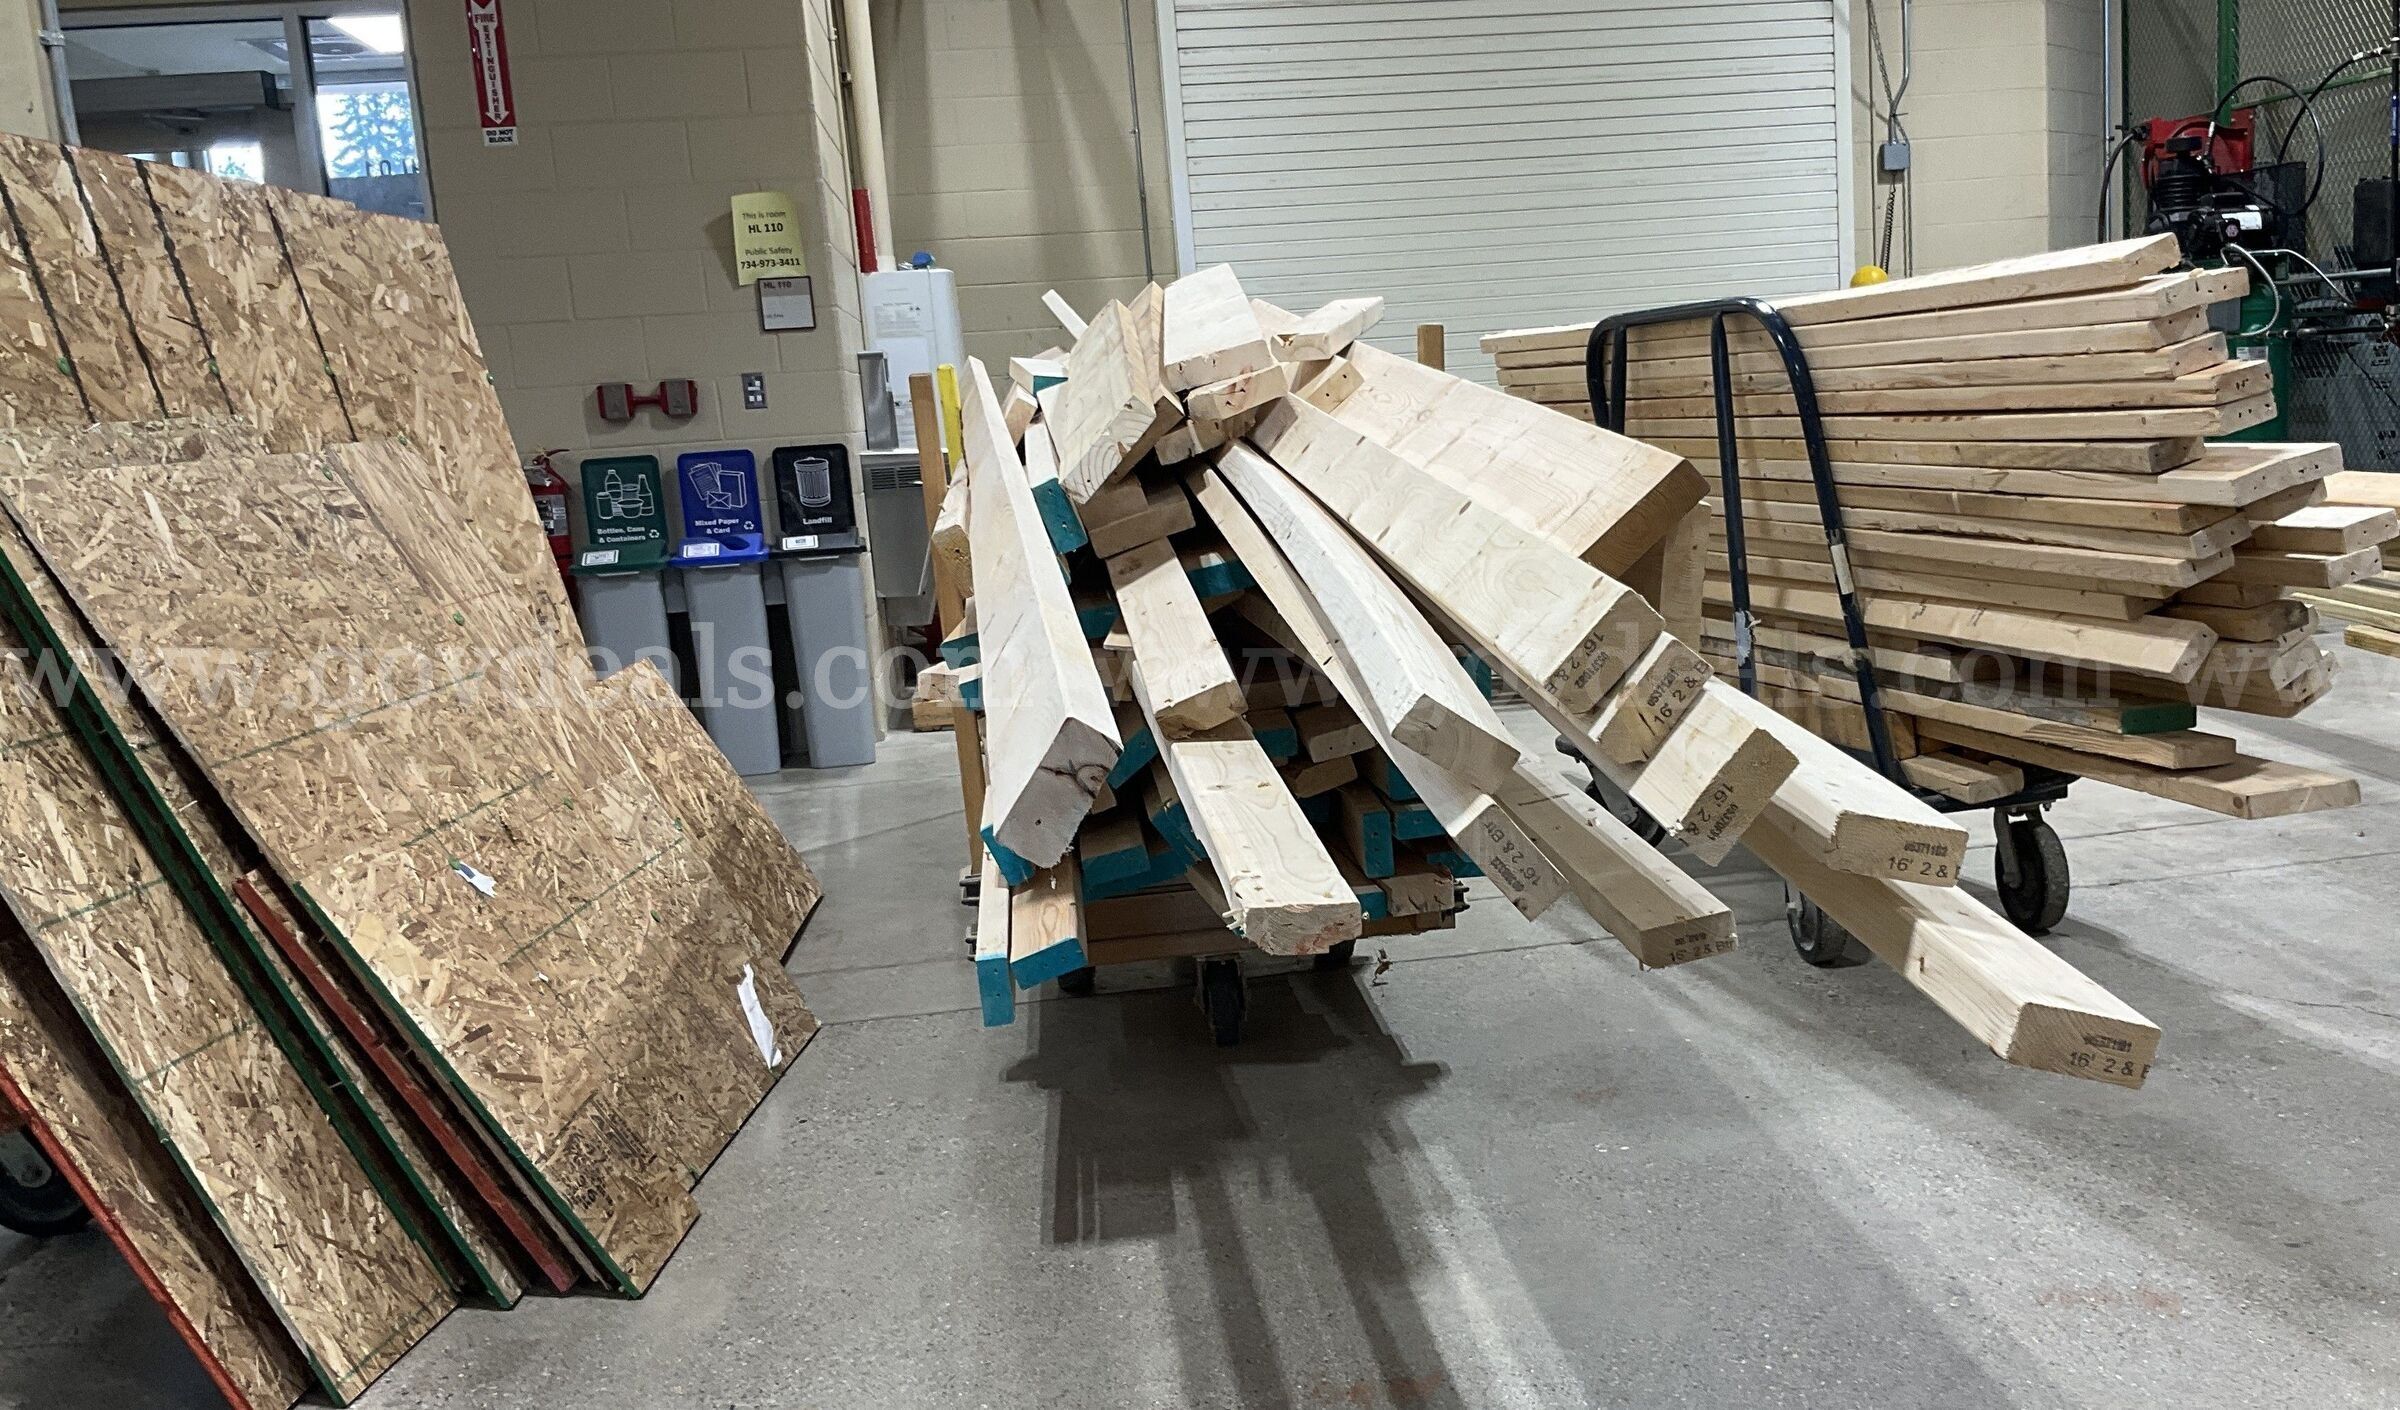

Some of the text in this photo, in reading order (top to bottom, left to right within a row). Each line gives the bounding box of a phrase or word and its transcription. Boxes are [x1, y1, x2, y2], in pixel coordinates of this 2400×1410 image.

[475, 13, 495, 23] FIRE
[483, 25, 501, 120] EXTINGUISHER
[488, 136, 513, 144] BLOCK
[742, 212, 756, 220] This
[748, 222, 784, 234] HL 110
[745, 246, 793, 256] Public Safety
[740, 258, 801, 270] 734-973-3411
[695, 518, 740, 527] Mixed Paper
[802, 516, 833, 525] Landfill
[606, 535, 646, 543] Containers
[1570, 656, 1580, 669] 2
[1553, 669, 1569, 681] &
[1672, 690, 1686, 703] 2
[1684, 676, 1698, 689] &
[1697, 808, 1711, 822] 2
[1685, 822, 1700, 836] &
[1503, 840, 1515, 853] &
[1511, 851, 1524, 863] 2
[1920, 861, 1932, 876] 2
[1936, 864, 1948, 878] &
[2103, 1058, 2117, 1074] 2
[2121, 1061, 2134, 1076] &
